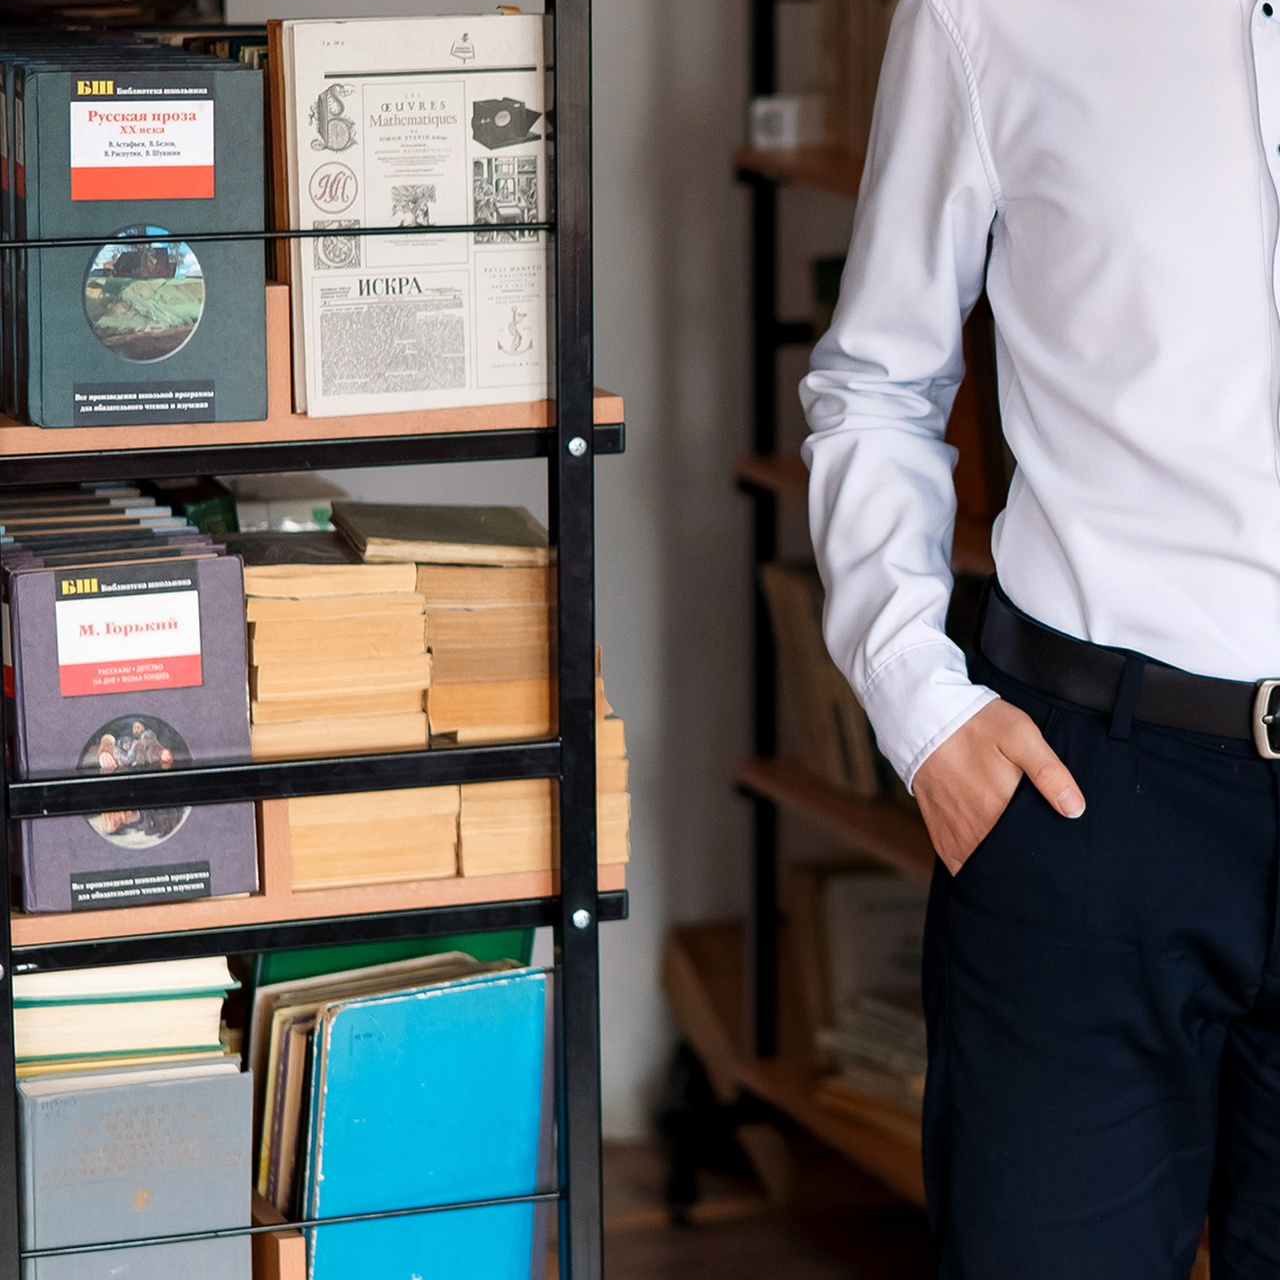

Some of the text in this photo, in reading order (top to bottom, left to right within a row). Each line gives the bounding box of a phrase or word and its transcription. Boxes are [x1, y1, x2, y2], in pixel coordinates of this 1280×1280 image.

[77, 80, 114, 96] БШ
[116, 86, 162, 95] Библиотека
[88, 110, 197, 126] Русская проза
[369, 114, 458, 128] Mathematiques
[140, 126, 165, 134] века
[358, 276, 423, 296] ИСКРА
[62, 578, 98, 595] БШ
[78, 617, 178, 638] М. Горький
